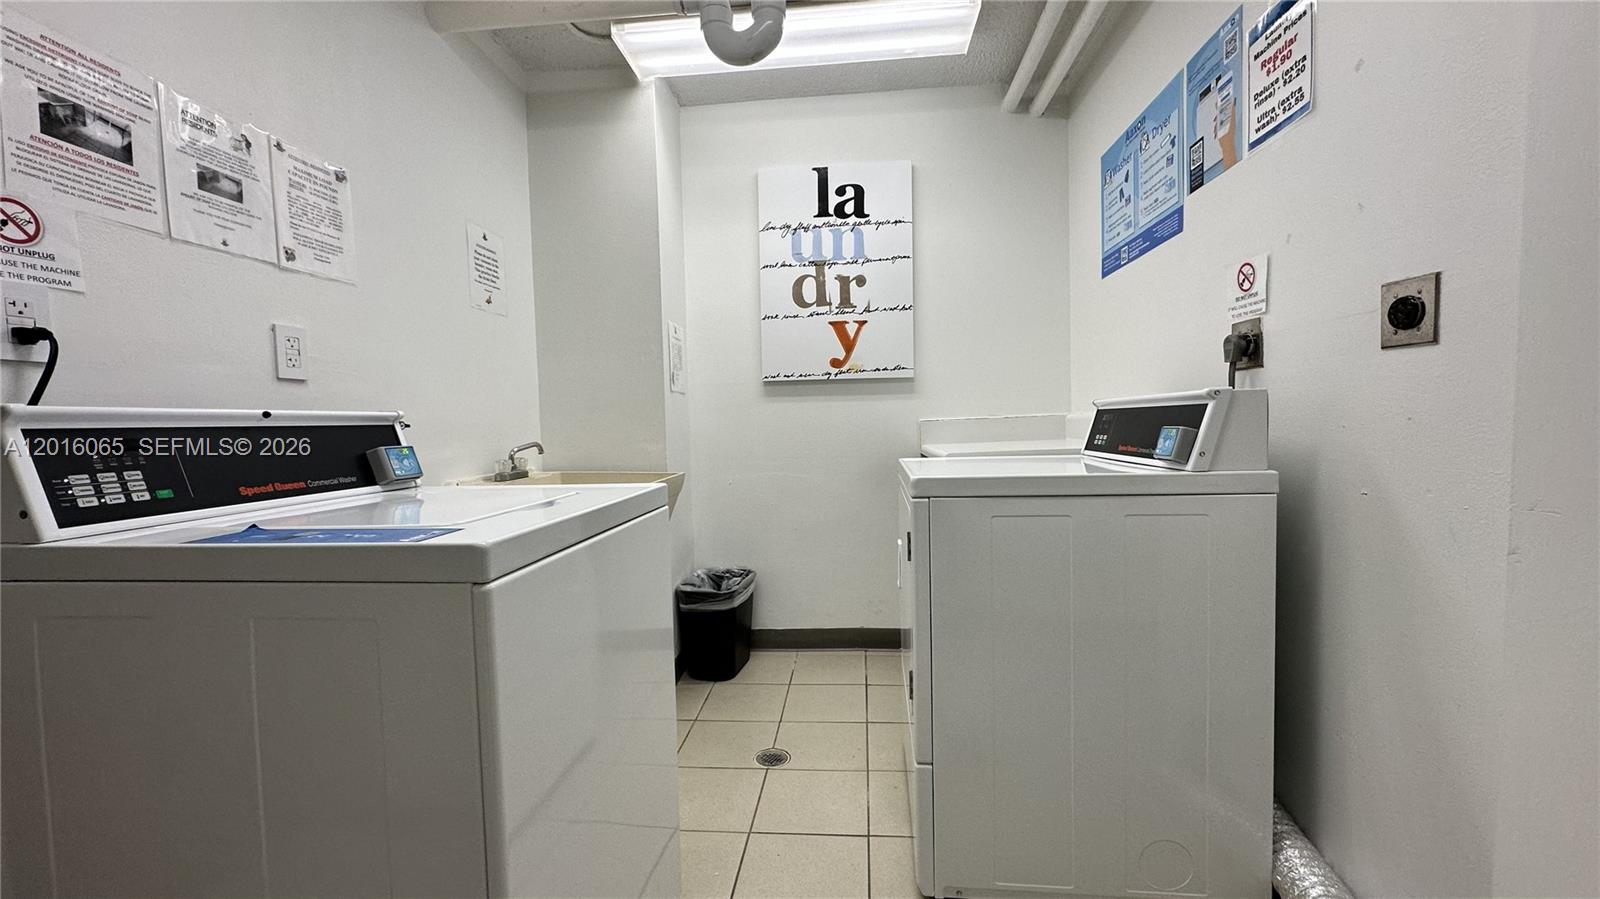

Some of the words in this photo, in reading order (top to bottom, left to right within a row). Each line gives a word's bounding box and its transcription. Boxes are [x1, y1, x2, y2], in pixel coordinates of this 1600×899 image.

[1253, 33, 1282, 61] Machine
[1283, 9, 1307, 35] Prices
[1260, 32, 1298, 71] Regular
[1253, 77, 1280, 102] Deluxe
[1281, 54, 1307, 80] (extra
[1265, 49, 1293, 77] $1.90
[1254, 87, 1276, 110] rinse)
[1282, 63, 1306, 87] $2.20
[1282, 91, 1305, 115] $2.55
[180, 107, 216, 129] ATTENTION
[1256, 106, 1276, 124] Ultra
[1277, 86, 1303, 110] (extra
[1151, 113, 1172, 139] Dryer
[812, 167, 870, 219] la
[17, 247, 56, 259] UNPLUG
[791, 227, 867, 263] un
[6, 271, 24, 280] THE
[26, 274, 71, 287] PROGRAM
[20, 261, 38, 270] THE
[40, 264, 80, 277] MACHINE
[792, 260, 867, 309] dr
[828, 320, 869, 369] y
[239, 483, 274, 496] Speed
[274, 481, 306, 491] Queen
[307, 478, 339, 488] Commercial
